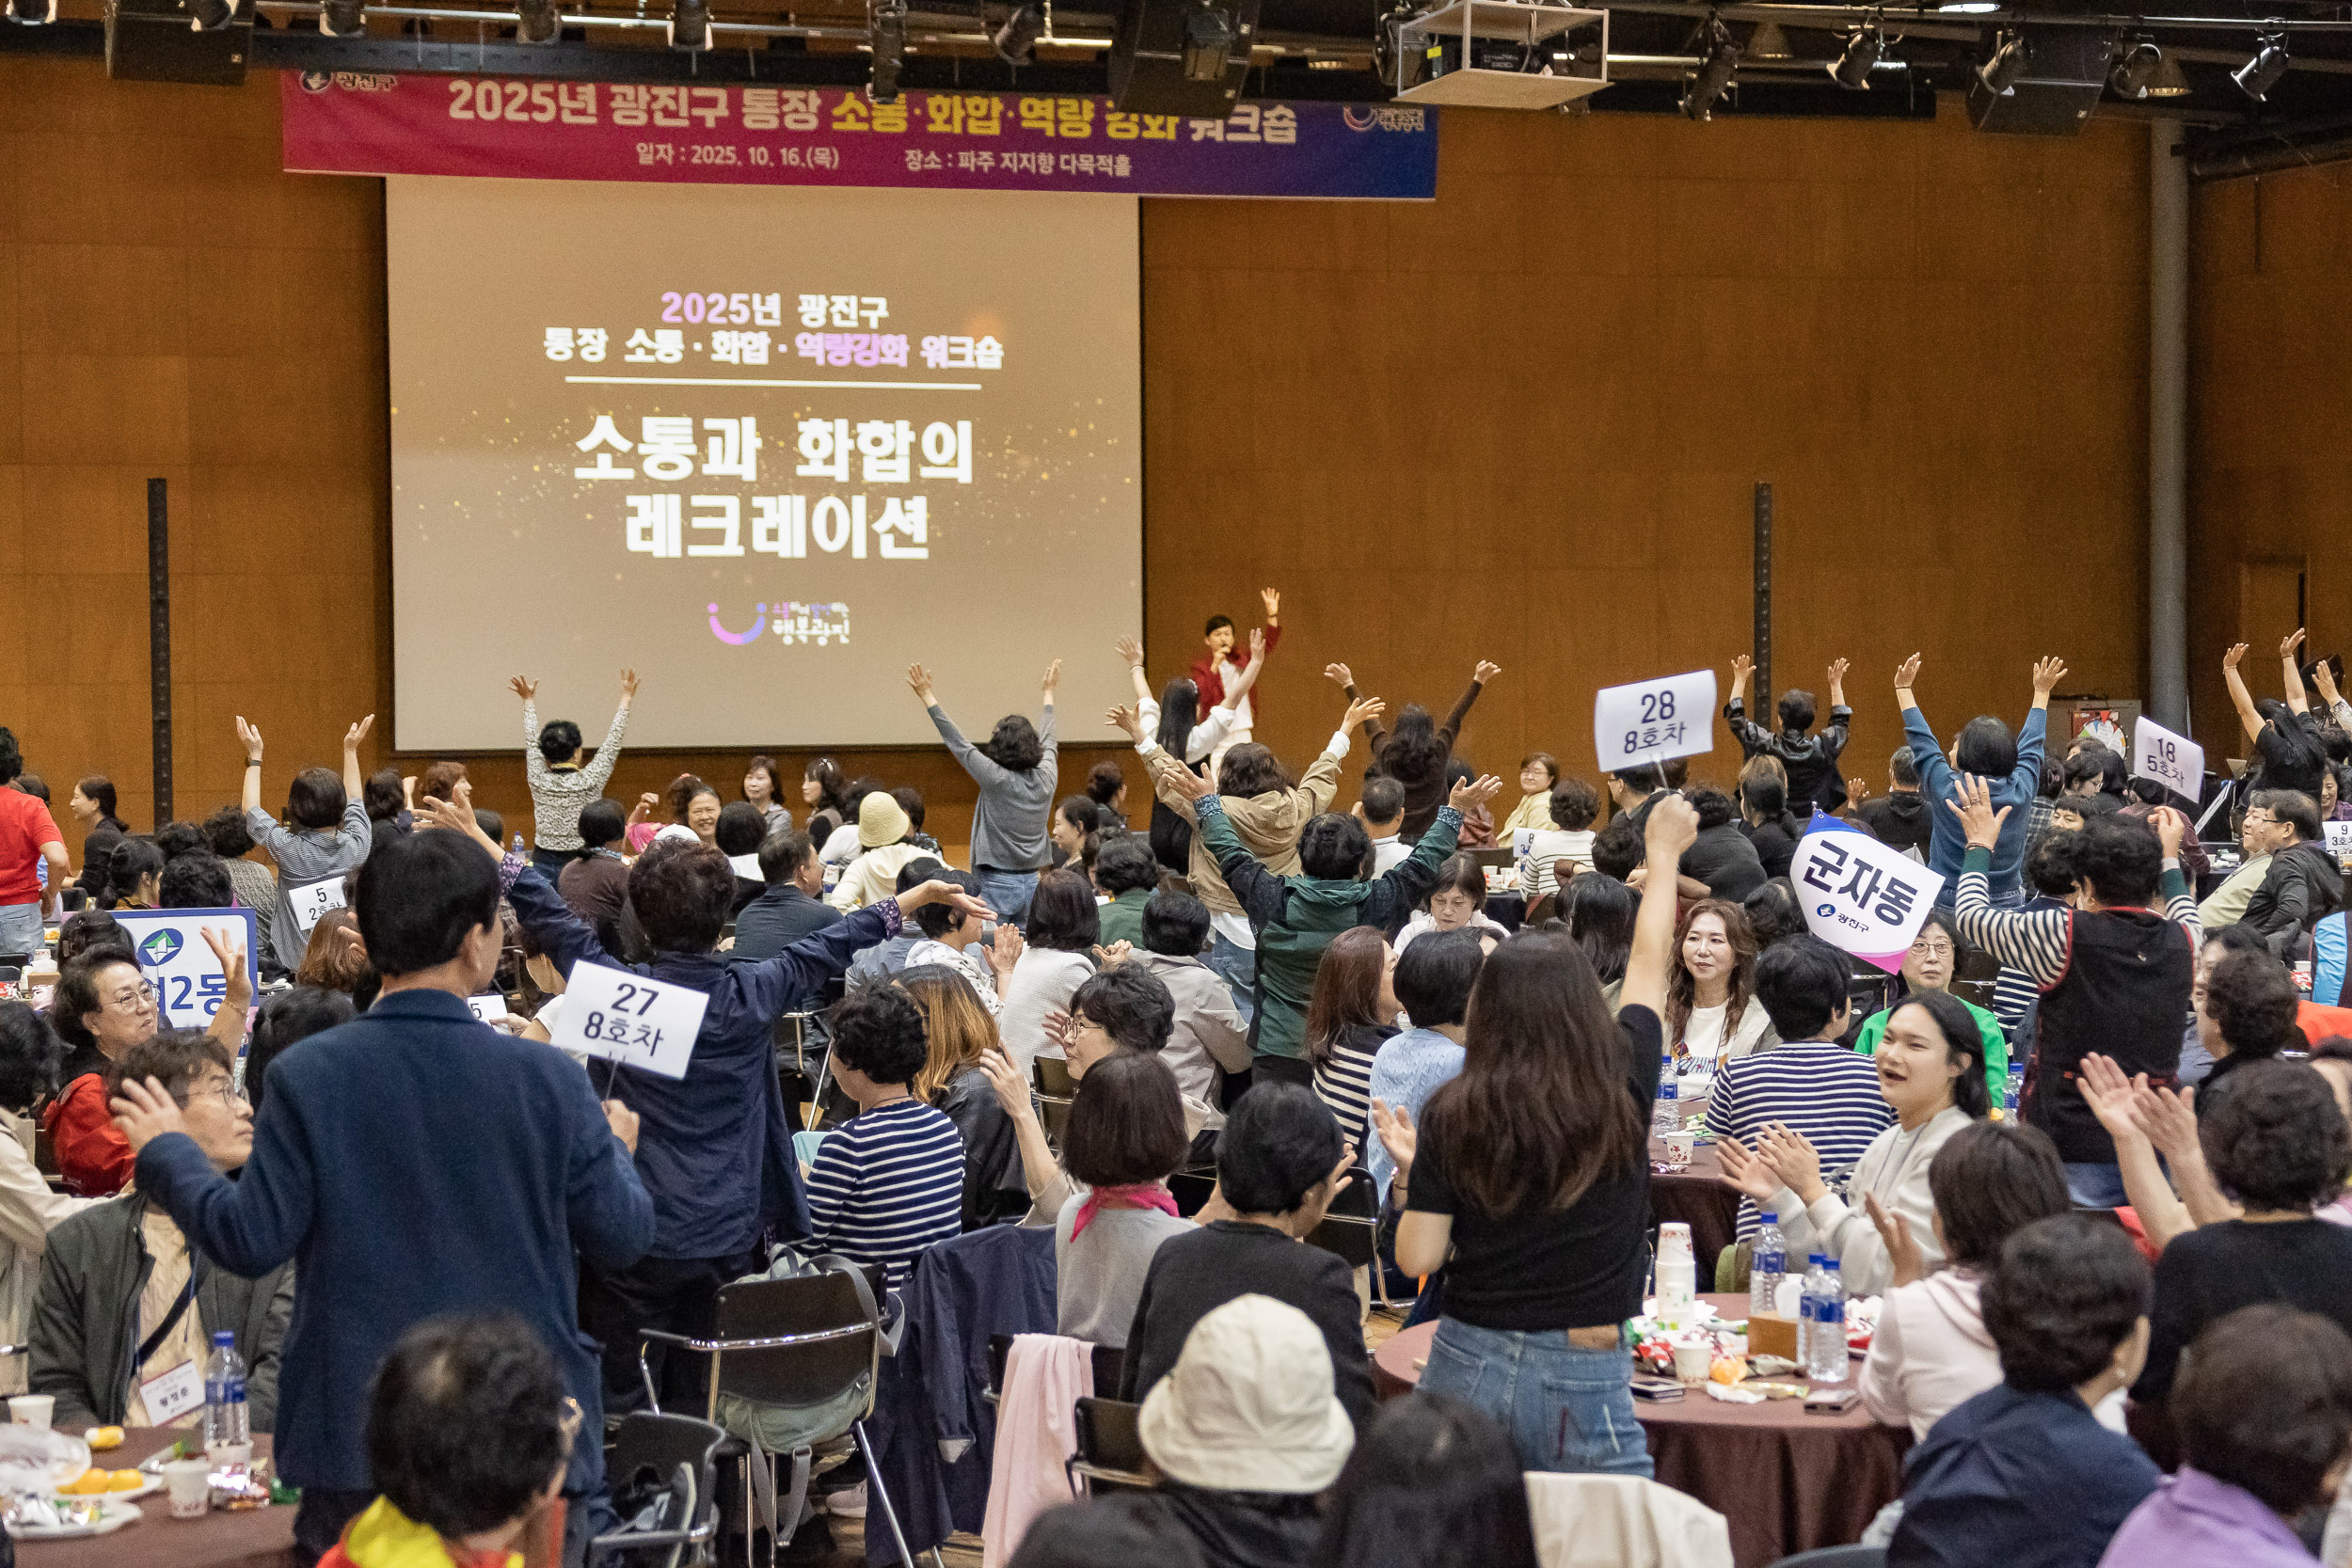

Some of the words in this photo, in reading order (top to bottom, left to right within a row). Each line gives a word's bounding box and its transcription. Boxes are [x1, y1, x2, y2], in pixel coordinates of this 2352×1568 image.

[449, 80, 597, 125] 2025년
[610, 85, 729, 128] 광진구
[741, 87, 821, 131] 통장
[635, 142, 675, 166] 일자
[691, 145, 742, 166] 2025.
[905, 149, 942, 171] 장소
[958, 150, 995, 173] 파주
[660, 291, 782, 327] 2025년
[797, 293, 890, 329] 광진구
[543, 326, 609, 363] 통장
[920, 334, 1004, 370] 워크숍
[573, 414, 762, 483] 소통과
[795, 418, 973, 483] 화합의
[625, 493, 930, 560] 레크레이션
[1641, 689, 1675, 723] 28
[1624, 721, 1687, 753] 8호차
[2157, 737, 2175, 763] 18
[2147, 754, 2185, 788] 5호차
[2342, 824, 2348, 835] 9
[316, 887, 326, 903] 5
[1803, 839, 1918, 927] 군자동
[1836, 912, 1870, 933] 광진구
[611, 983, 660, 1016] 27
[583, 1010, 664, 1057] 8호차
